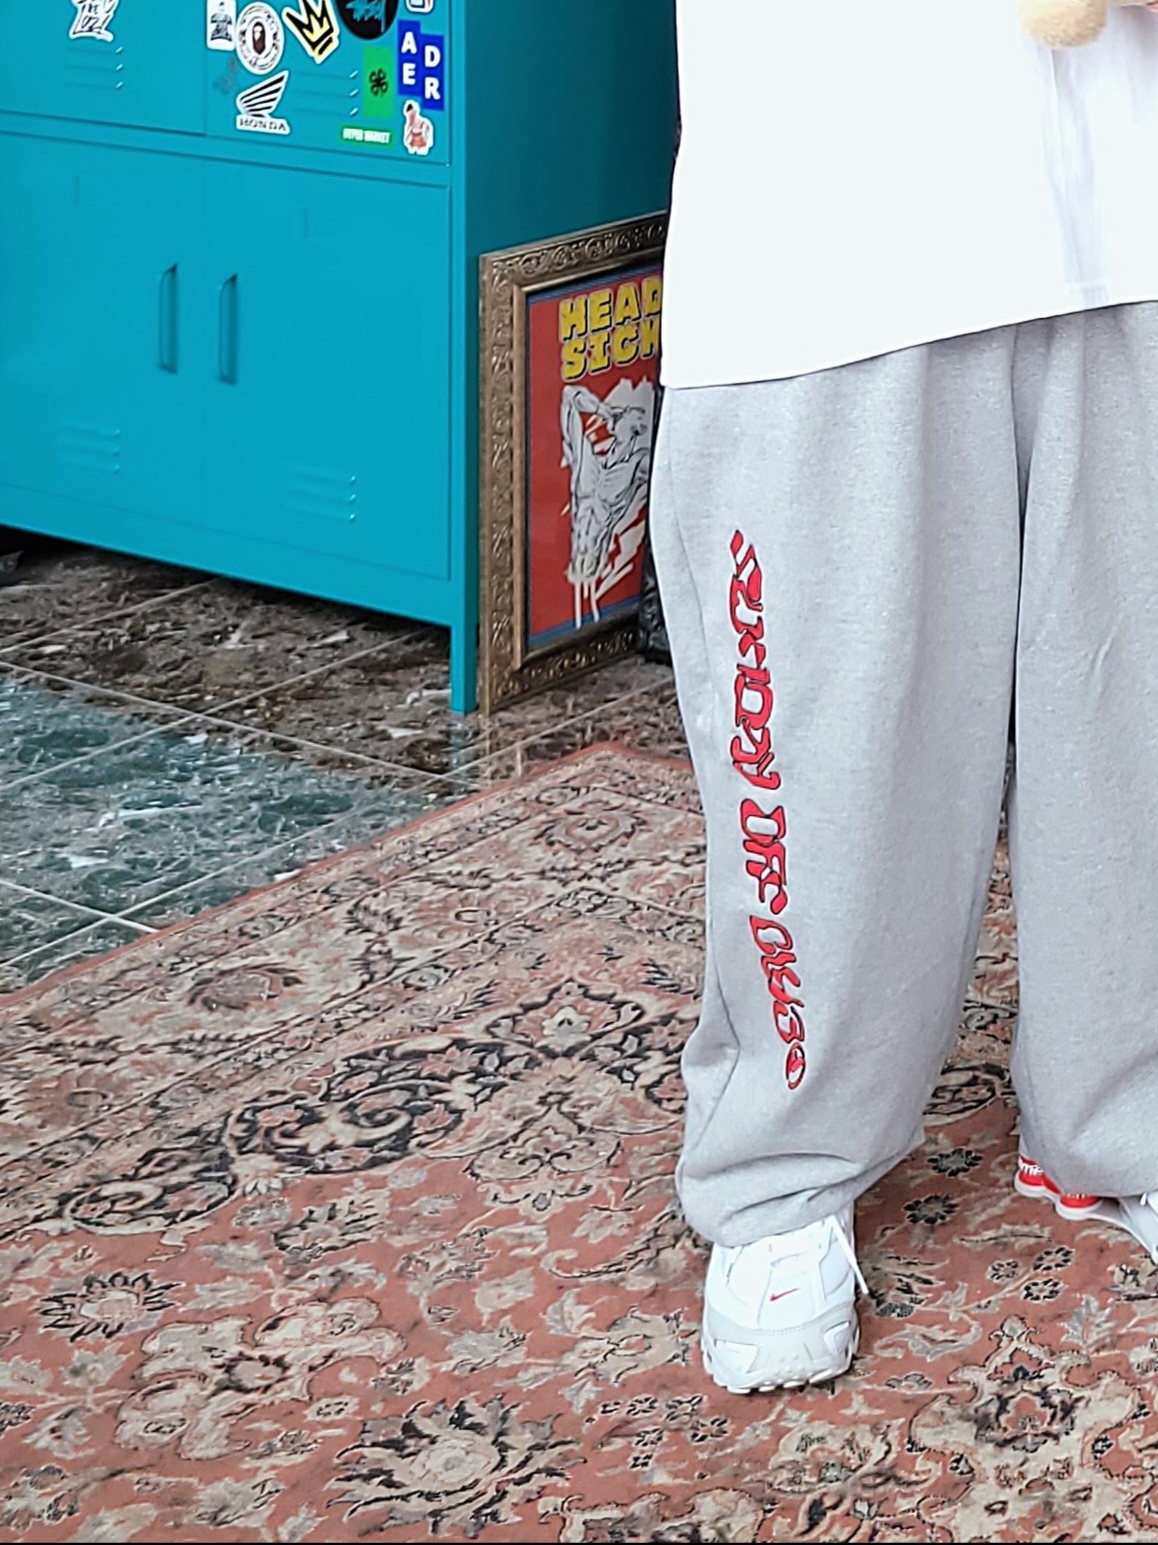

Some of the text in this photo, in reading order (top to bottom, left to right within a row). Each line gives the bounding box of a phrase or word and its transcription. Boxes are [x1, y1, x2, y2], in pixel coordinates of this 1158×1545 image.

[240, 118, 288, 132] HONDA
[559, 276, 662, 343] HEAD
[740, 798, 788, 916] OFF
